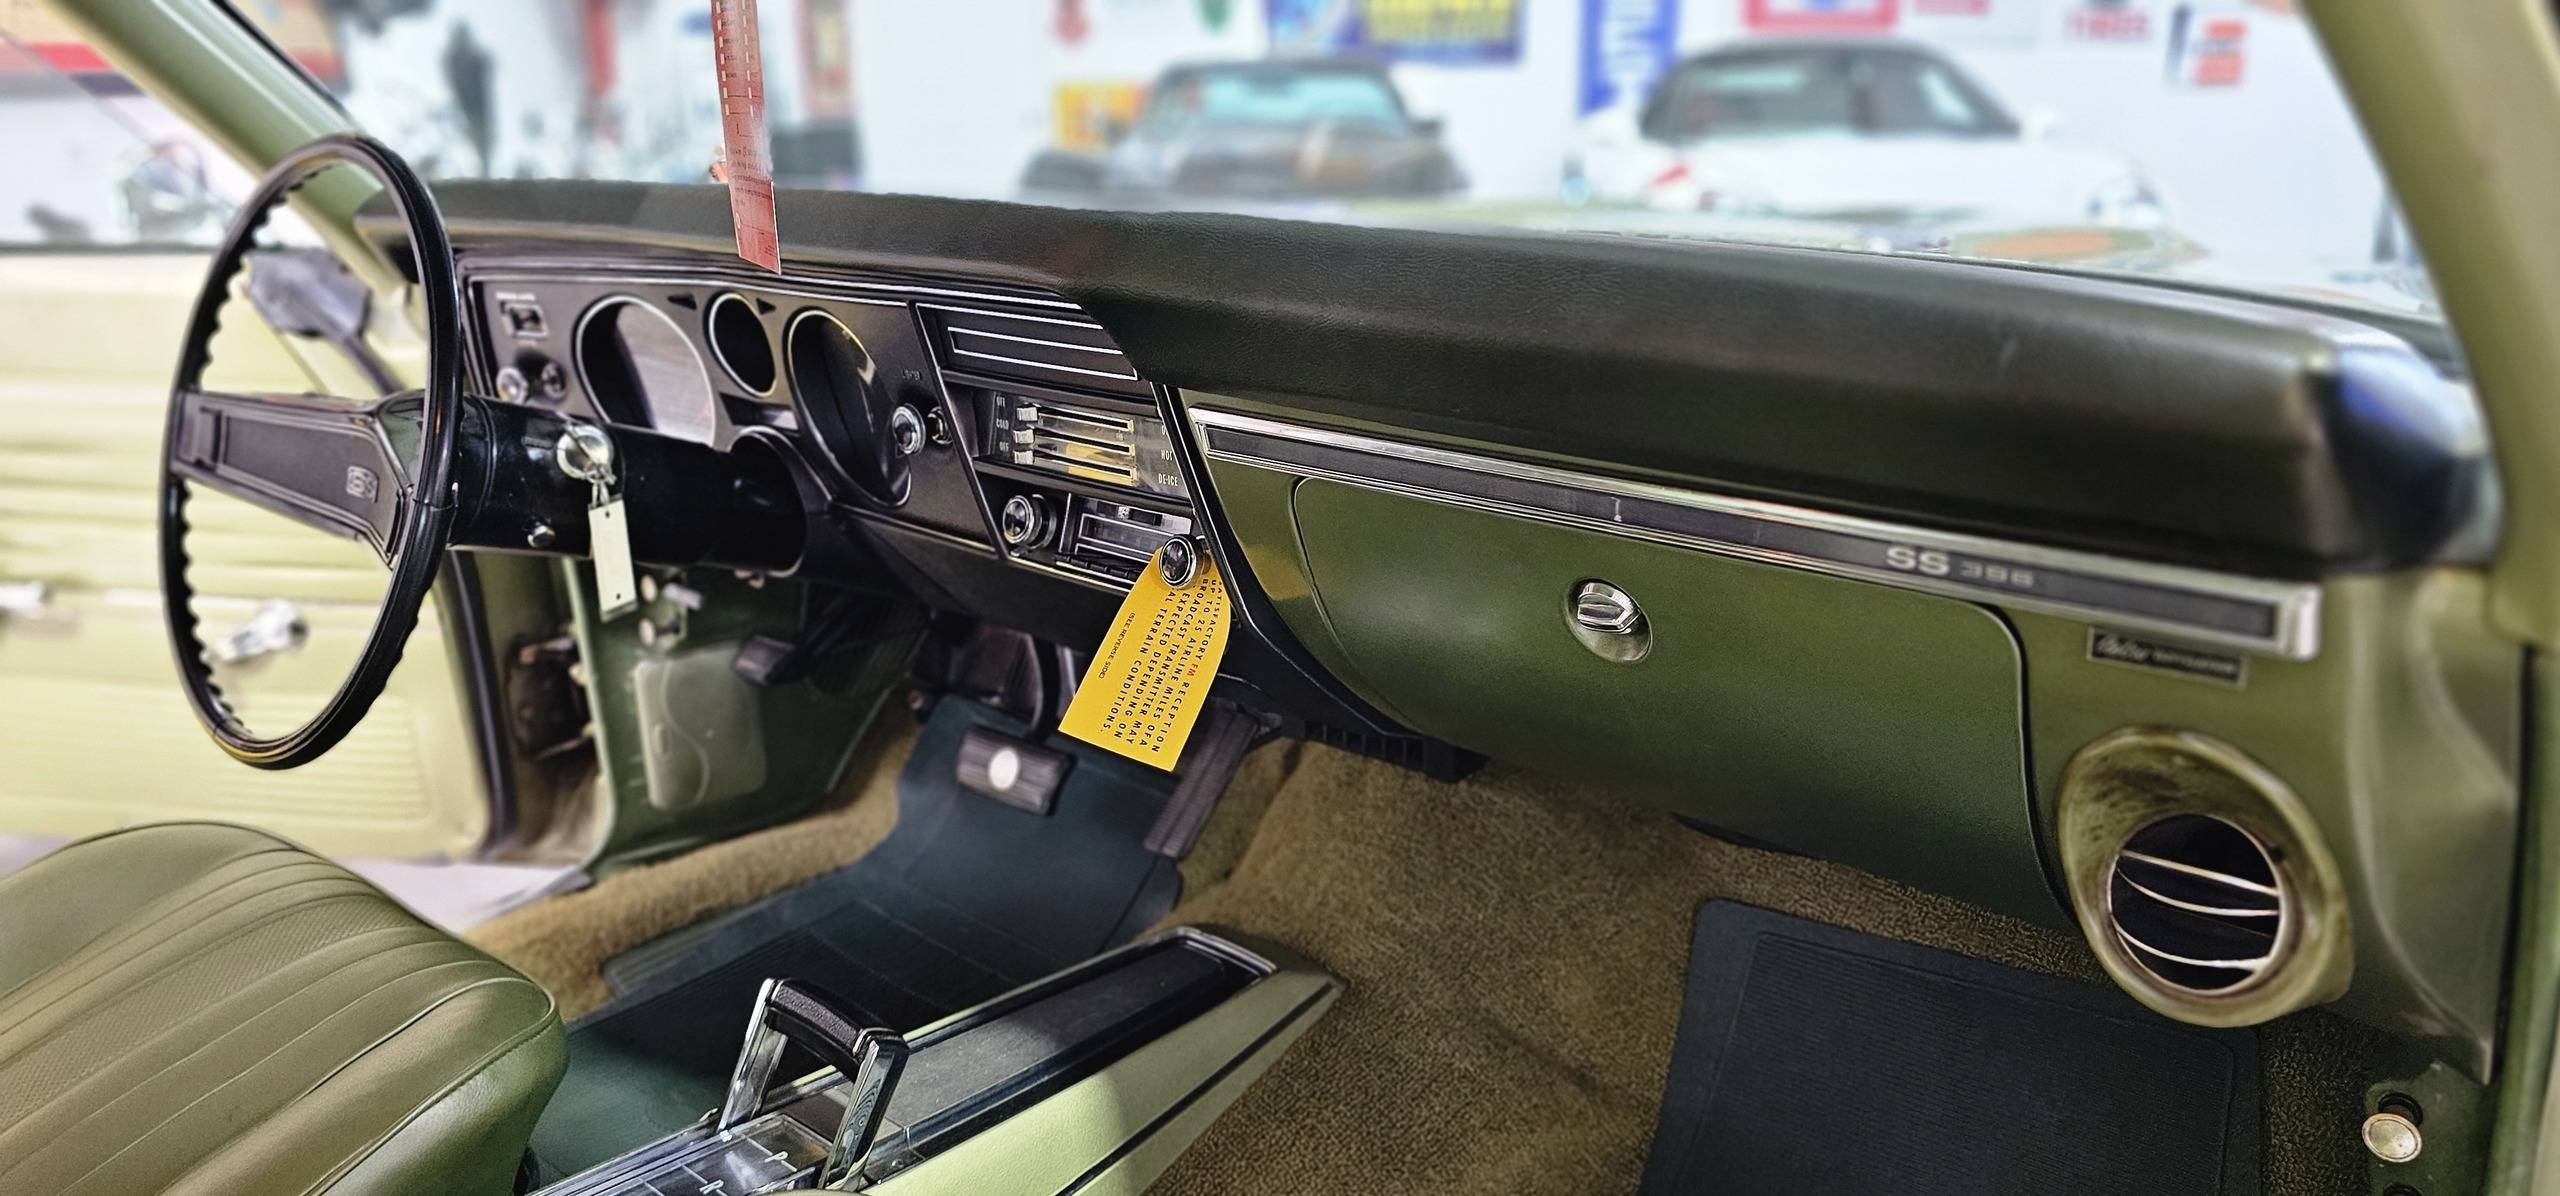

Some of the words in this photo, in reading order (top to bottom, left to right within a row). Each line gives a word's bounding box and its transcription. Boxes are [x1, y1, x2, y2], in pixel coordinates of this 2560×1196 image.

[1158, 473, 1178, 487] DE-ICE
[1886, 545, 1950, 577] SS
[1210, 579, 1217, 594] UP
[1159, 592, 1190, 646] EXPECTED
[1177, 578, 1209, 639] BROADCAST
[1196, 582, 1222, 660] ATISFACTORY
[1203, 600, 1213, 613] TO
[1139, 608, 1167, 654] TERRAIN
[1194, 619, 1205, 632] 25
[1107, 628, 1127, 660] REVERSE
[1171, 637, 1197, 682] AIRLINE
[1124, 652, 1161, 717] DEPENDING
[1139, 643, 1180, 716] TRANSMITTER
[1187, 663, 1199, 677] FM
[1151, 682, 1190, 753] RECEPTION
[1153, 686, 1174, 719] MILES
[1113, 723, 1127, 739] ON
[1126, 721, 1142, 745] MAY
[764, 1150, 789, 1163] P
